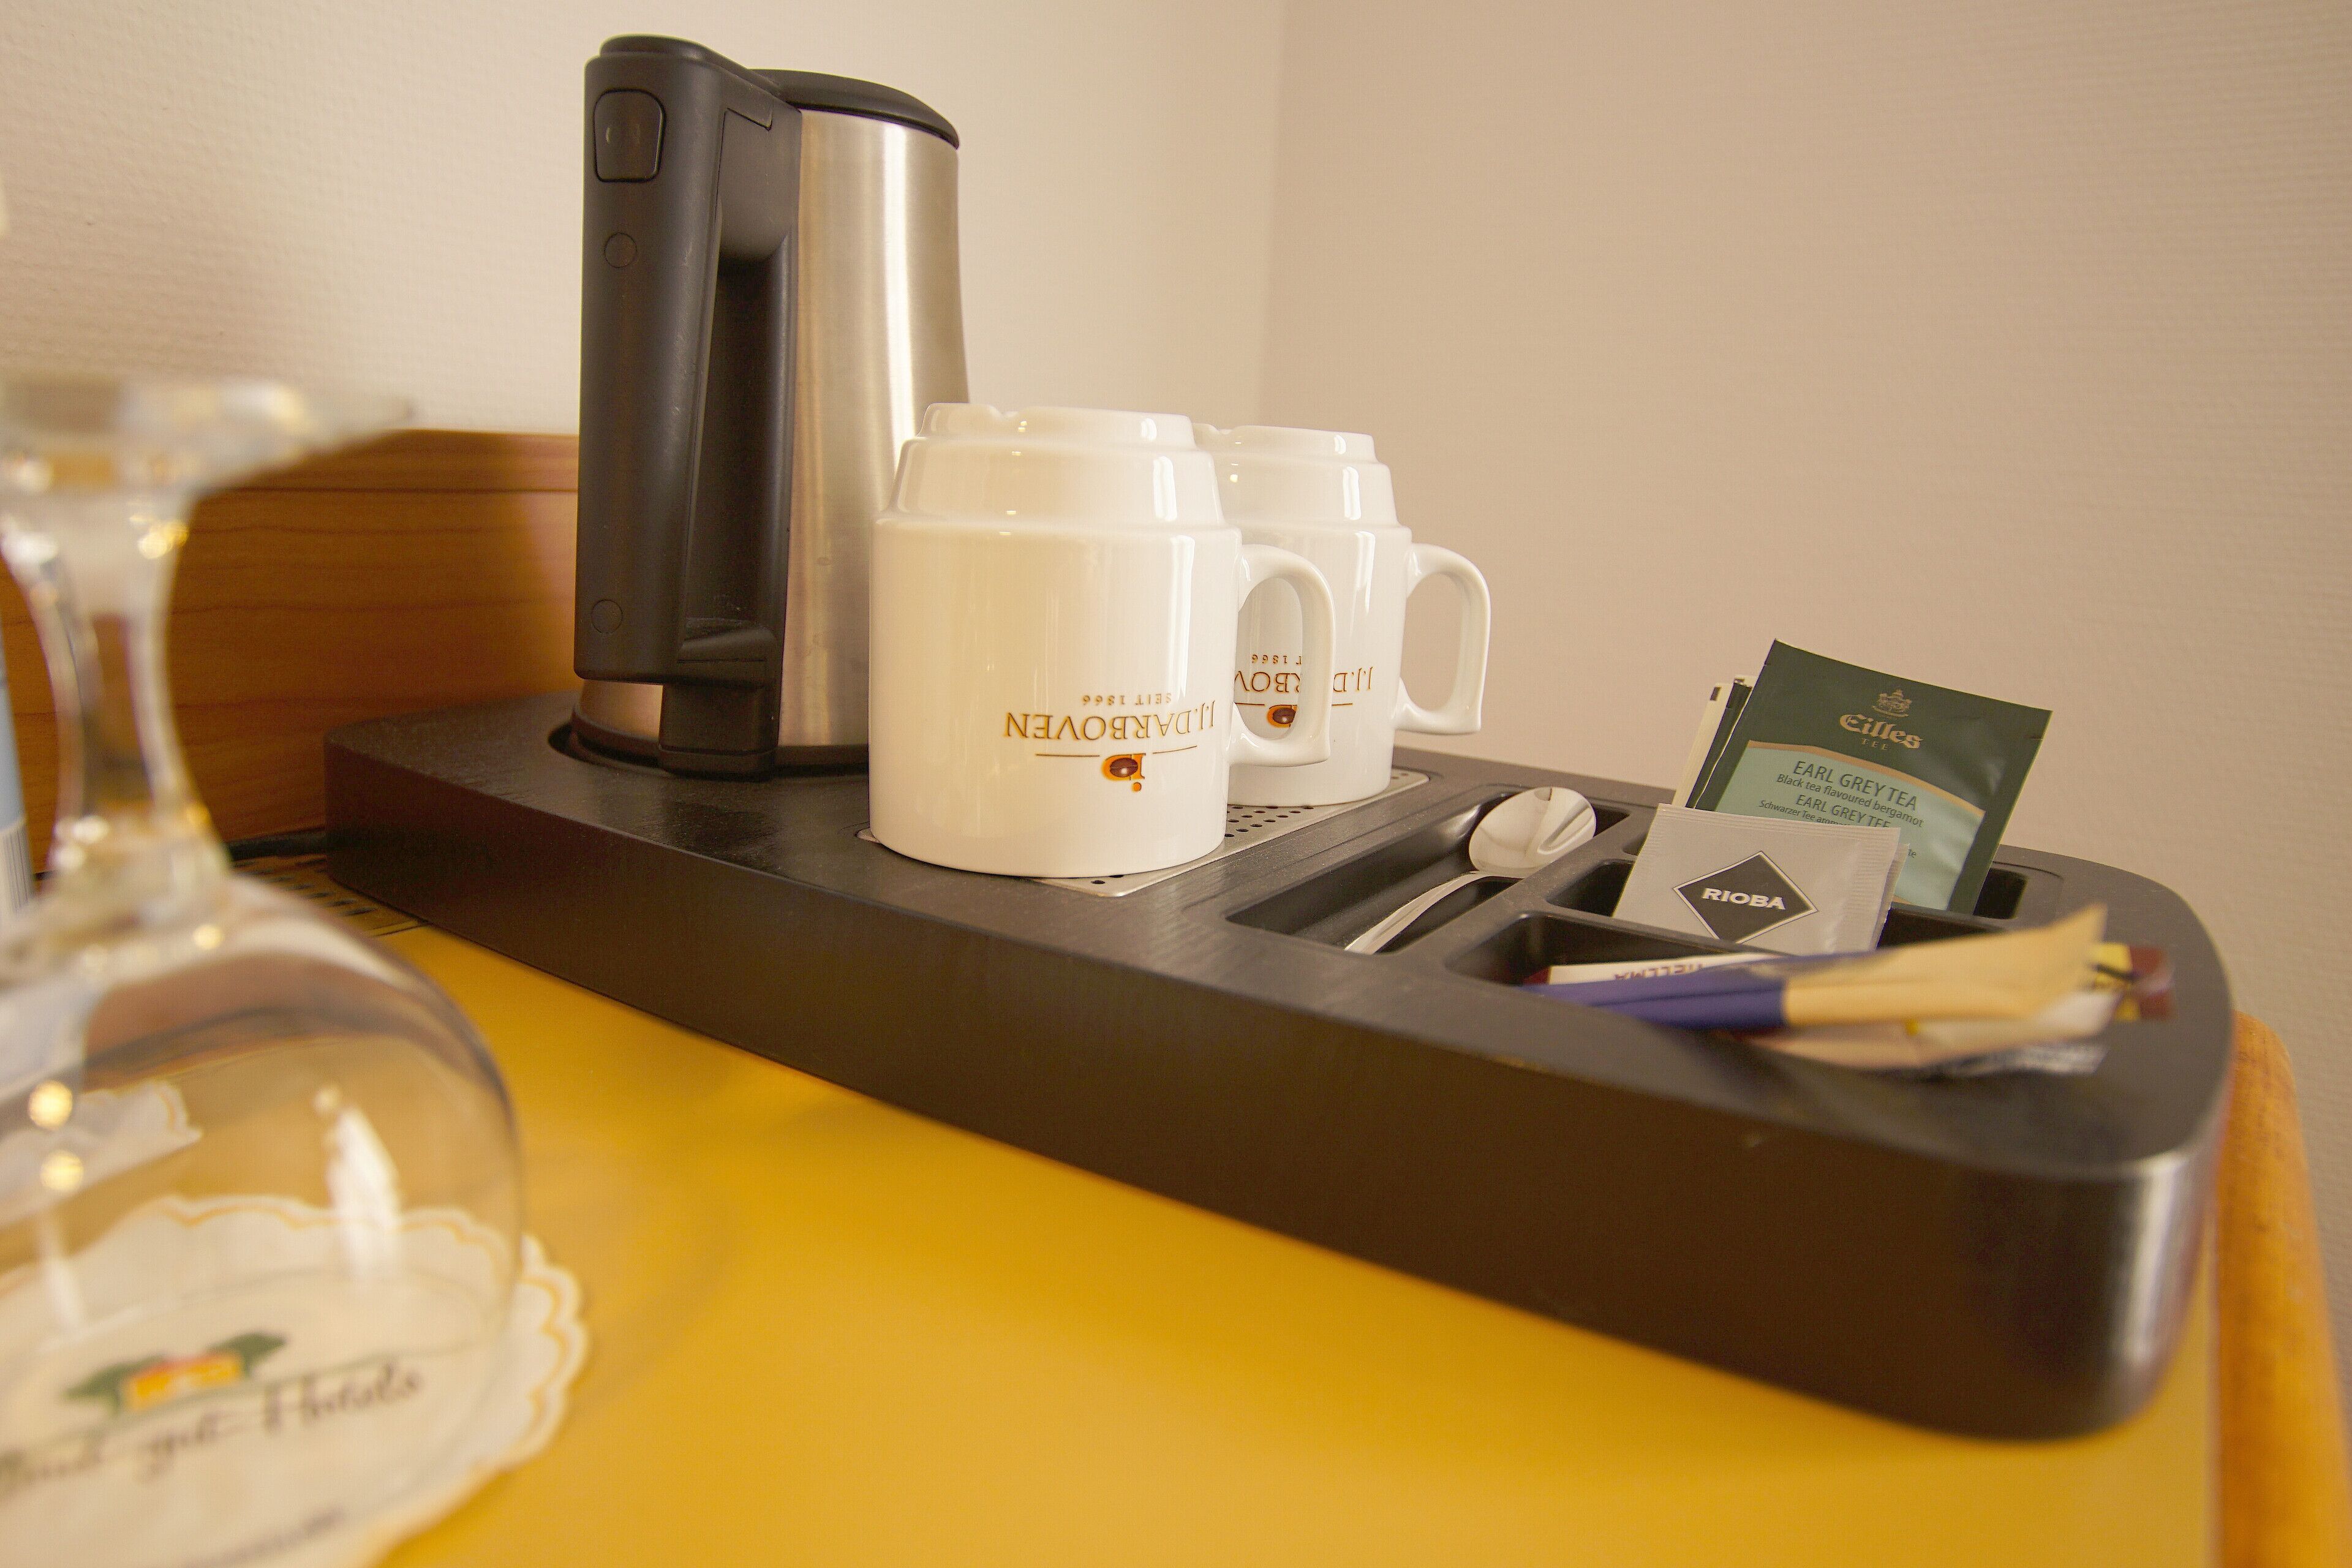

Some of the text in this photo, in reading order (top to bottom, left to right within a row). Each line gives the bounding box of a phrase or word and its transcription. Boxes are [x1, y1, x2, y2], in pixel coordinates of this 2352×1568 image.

[1082, 692, 1172, 706] SEIT 1866
[1839, 714, 1924, 749] Eilles
[1861, 737, 1890, 751] TEE
[1793, 760, 1918, 812] EARL GREY TEA
[1758, 799, 1801, 817] Schwarzer
[1801, 810, 1816, 821] Tee
[1776, 773, 1925, 828] Black tea flavoured bergamot
[1795, 794, 1828, 813] EARL
[1830, 804, 1868, 824] GREY
[1702, 888, 1787, 911] RIOBA
